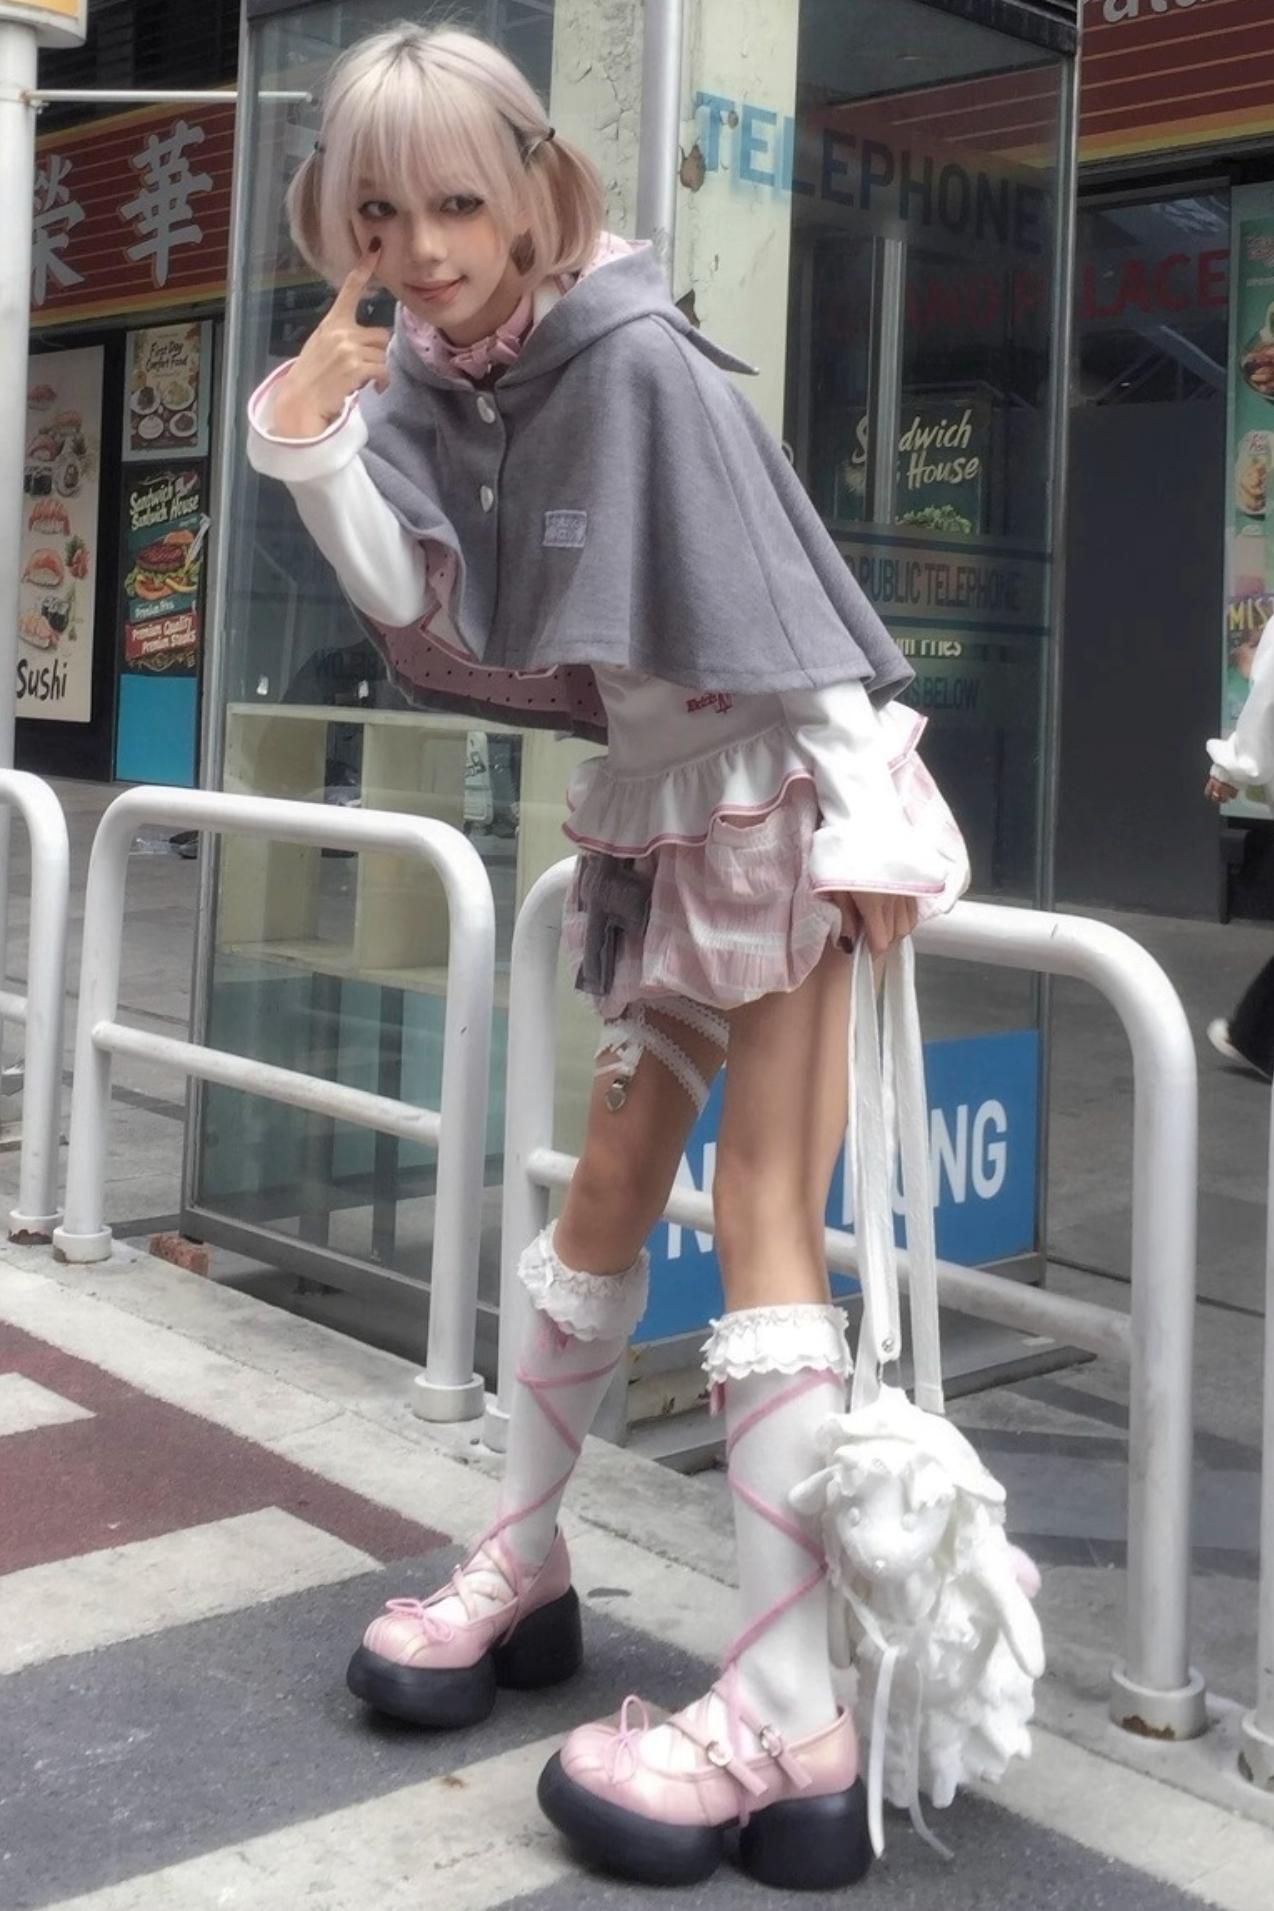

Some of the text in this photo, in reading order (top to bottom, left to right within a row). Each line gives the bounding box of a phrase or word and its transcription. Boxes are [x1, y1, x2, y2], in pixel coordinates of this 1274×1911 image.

[695, 91, 1043, 256] TELEPHONE
[907, 452, 980, 490] House
[859, 555, 921, 604] PUBLIC
[16, 658, 67, 701] Sushi
